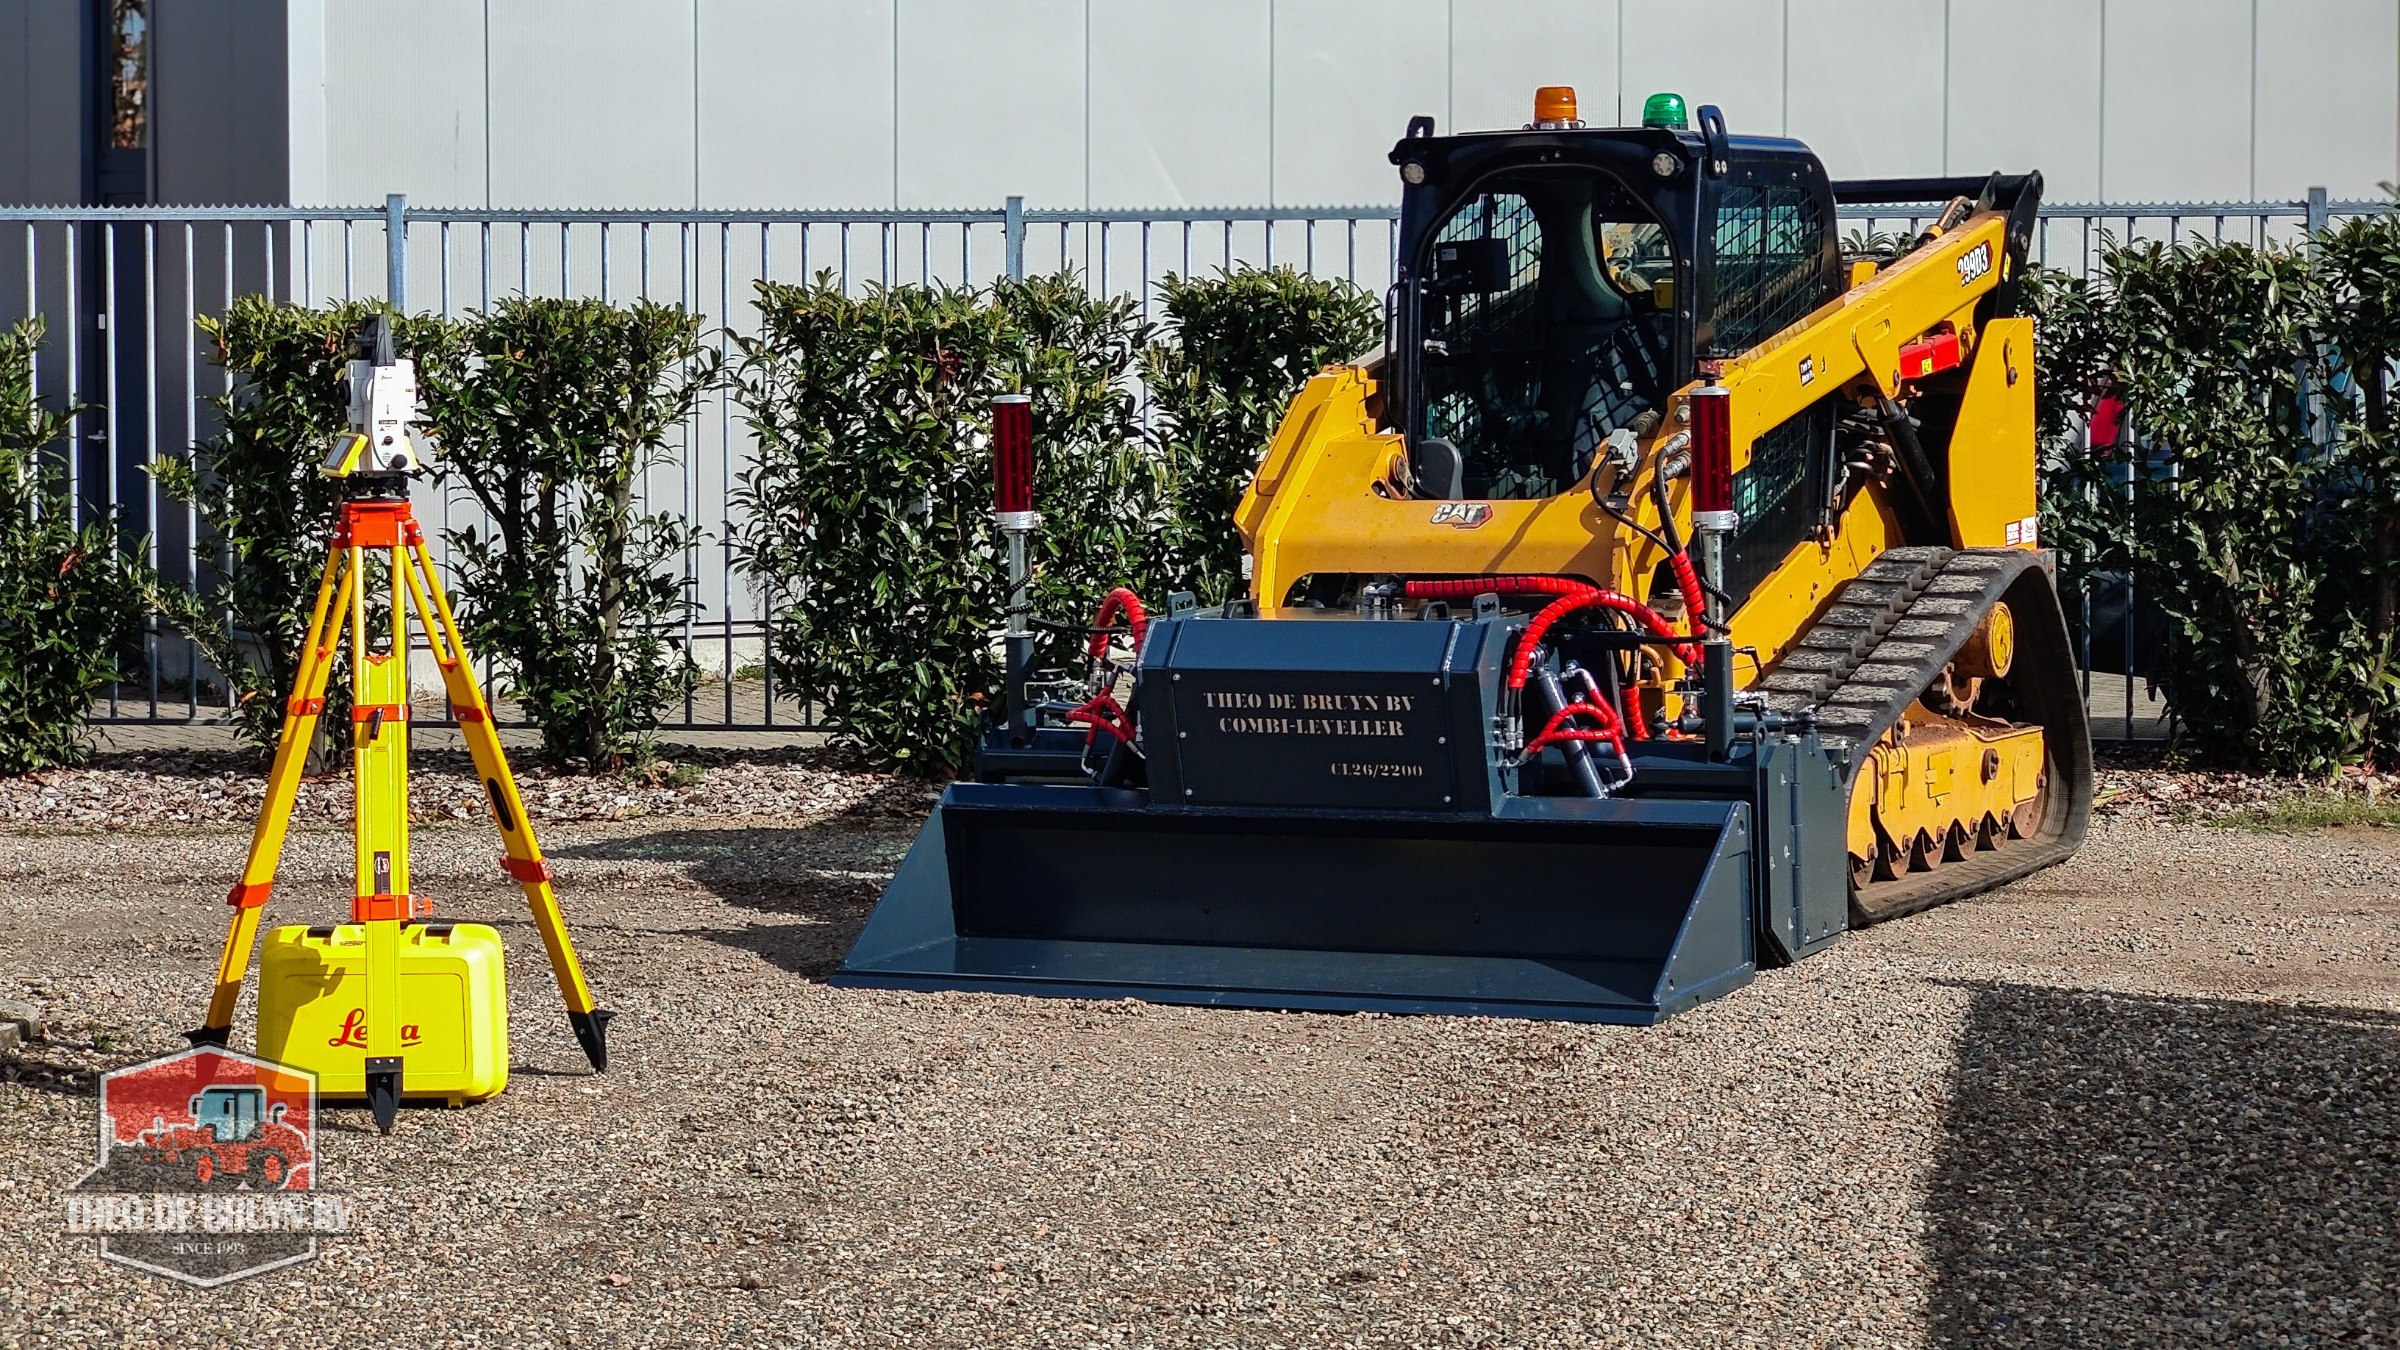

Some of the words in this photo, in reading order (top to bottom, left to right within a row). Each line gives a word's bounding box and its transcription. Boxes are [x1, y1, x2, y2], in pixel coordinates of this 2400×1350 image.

[1957, 243, 1988, 286] 299D3
[1431, 503, 1489, 524] CAT
[1203, 692, 1262, 708] THEO
[1269, 694, 1296, 709] DE
[1303, 694, 1379, 710] BRUYN
[1386, 696, 1415, 711] BV
[1219, 717, 1404, 736] COMBI-LEVELLER
[1330, 763, 1423, 778] CL26/2200
[328, 1007, 422, 1049] Lea
